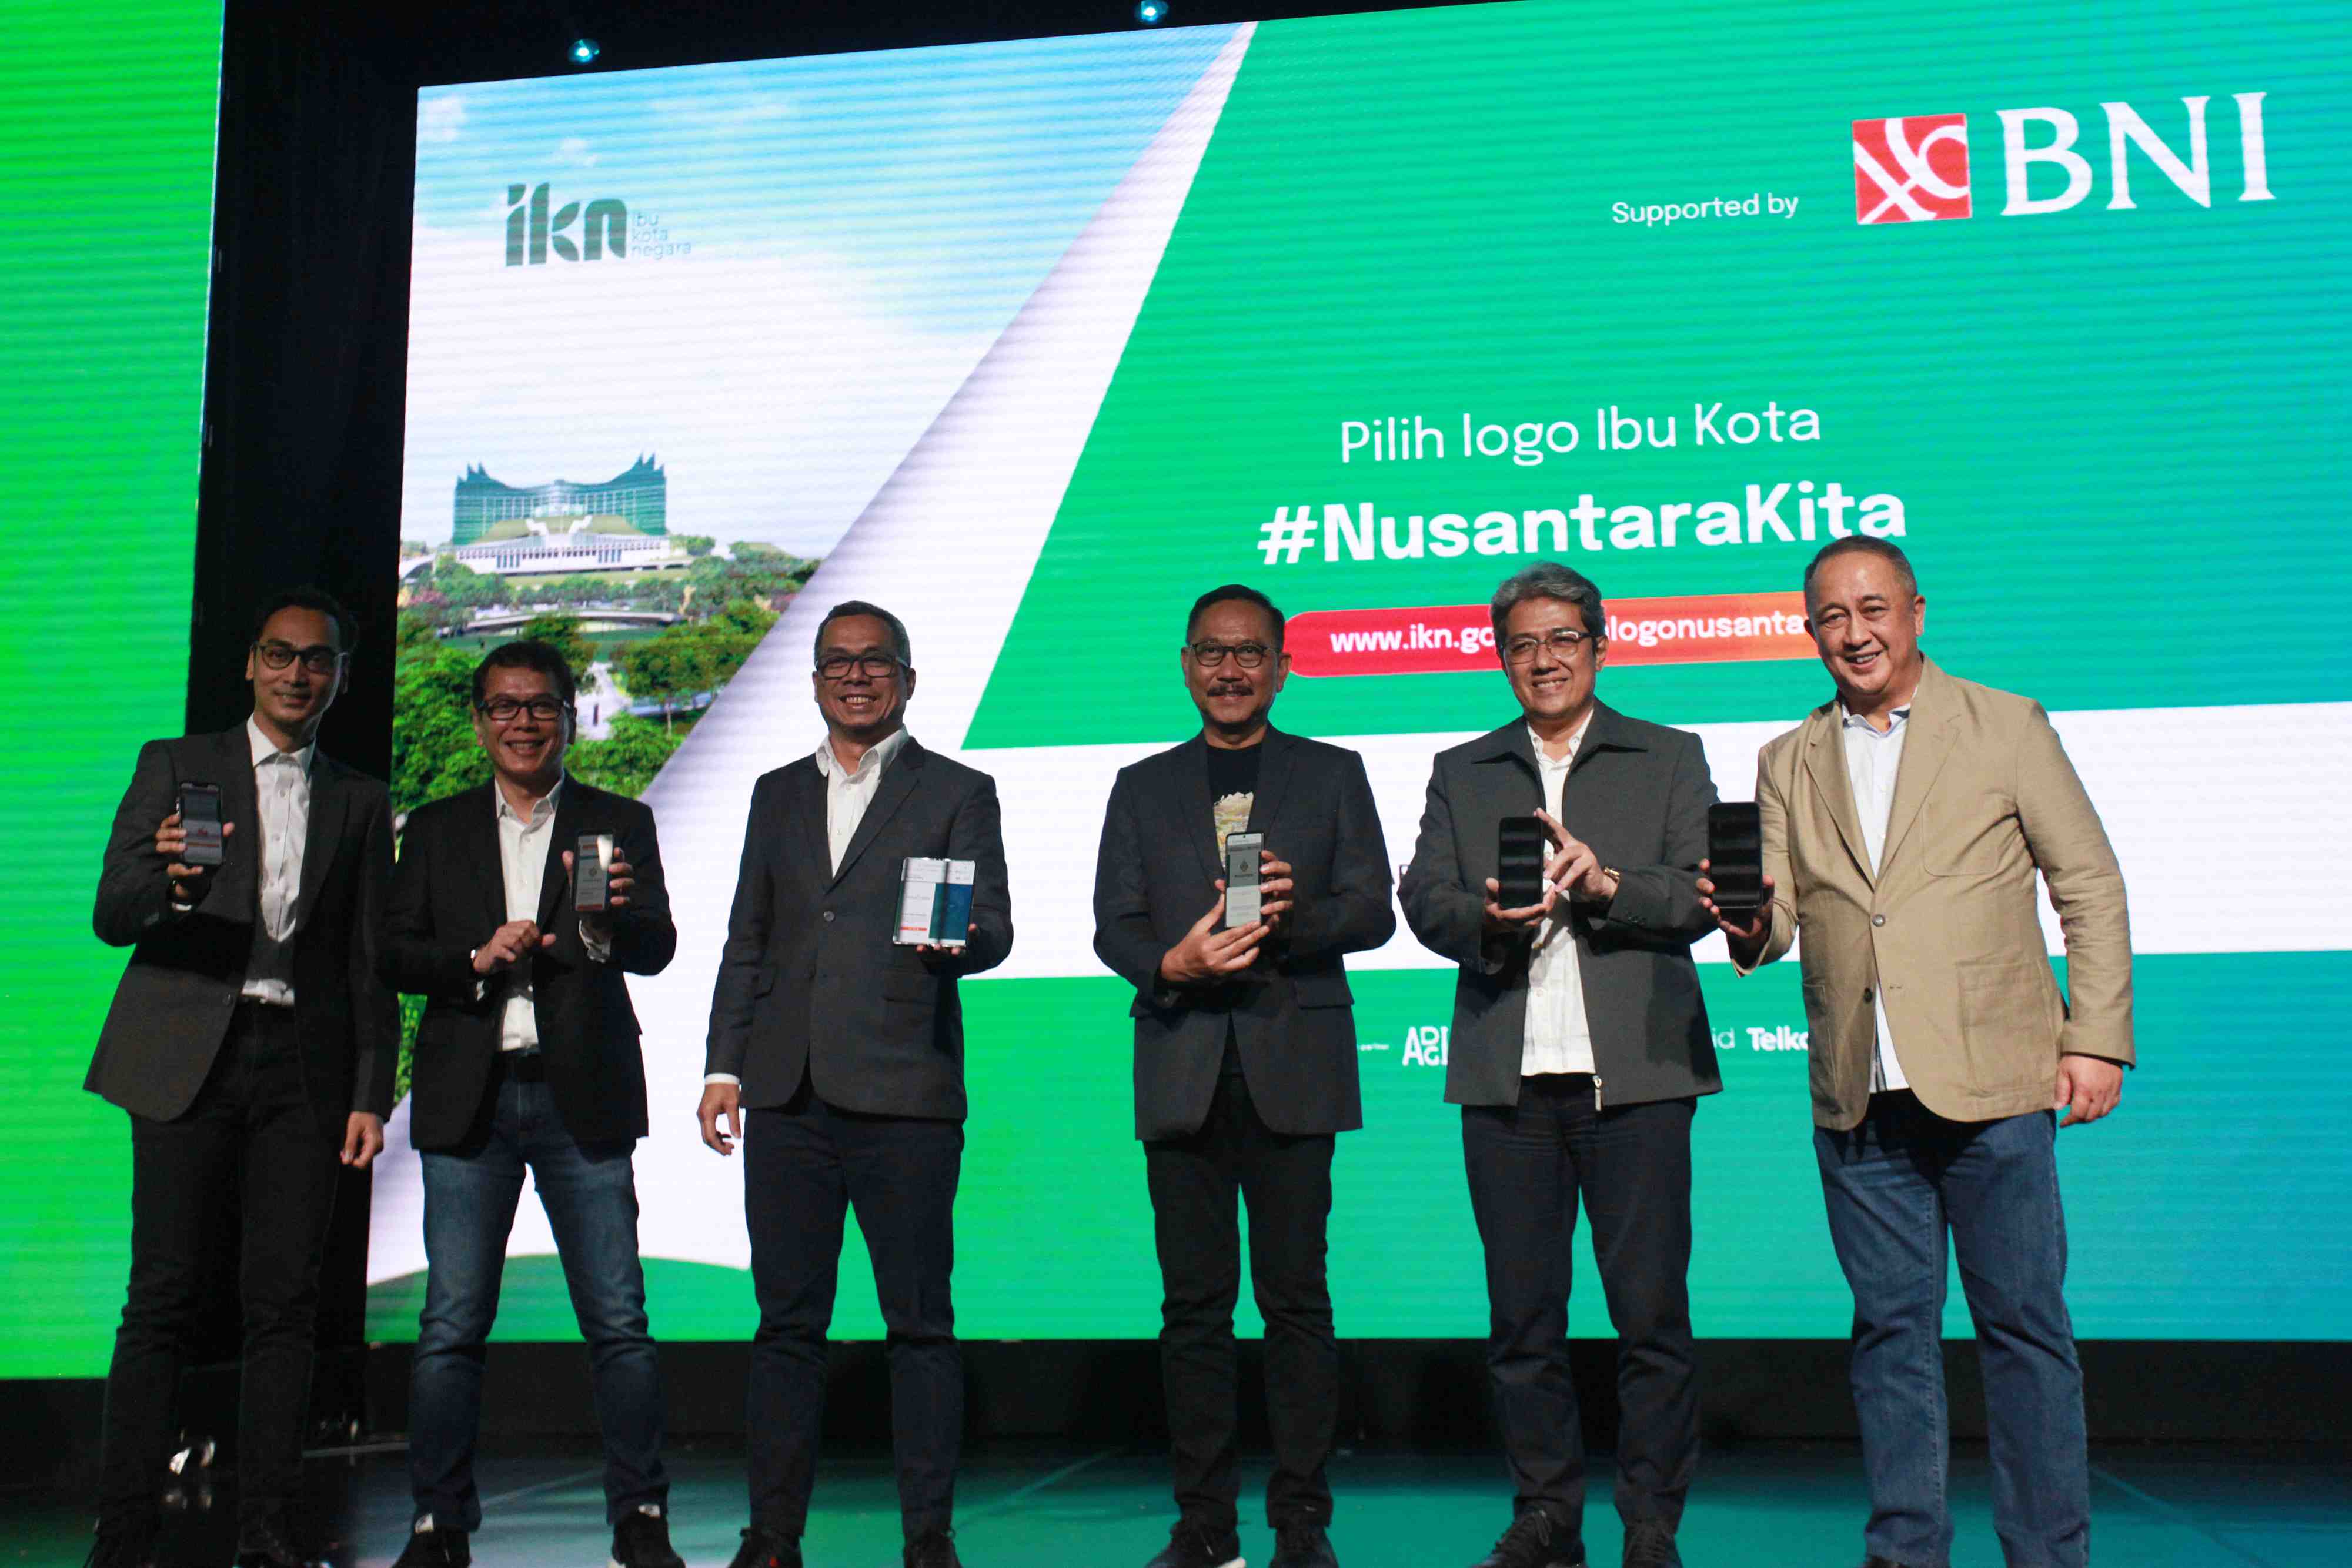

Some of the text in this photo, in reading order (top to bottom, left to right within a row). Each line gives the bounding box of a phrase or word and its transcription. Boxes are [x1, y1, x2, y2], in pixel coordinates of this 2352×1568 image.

[1996, 92, 2276, 216] BNI
[506, 182, 627, 266] ikn
[631, 227, 669, 242] kota
[1612, 193, 1799, 227] Supported by
[631, 242, 691, 260] negara
[1342, 402, 1821, 467] Pilih logo Ibu Kota
[1257, 480, 1907, 564] #NusantaraKita
[1605, 611, 1805, 647] logonusanta
